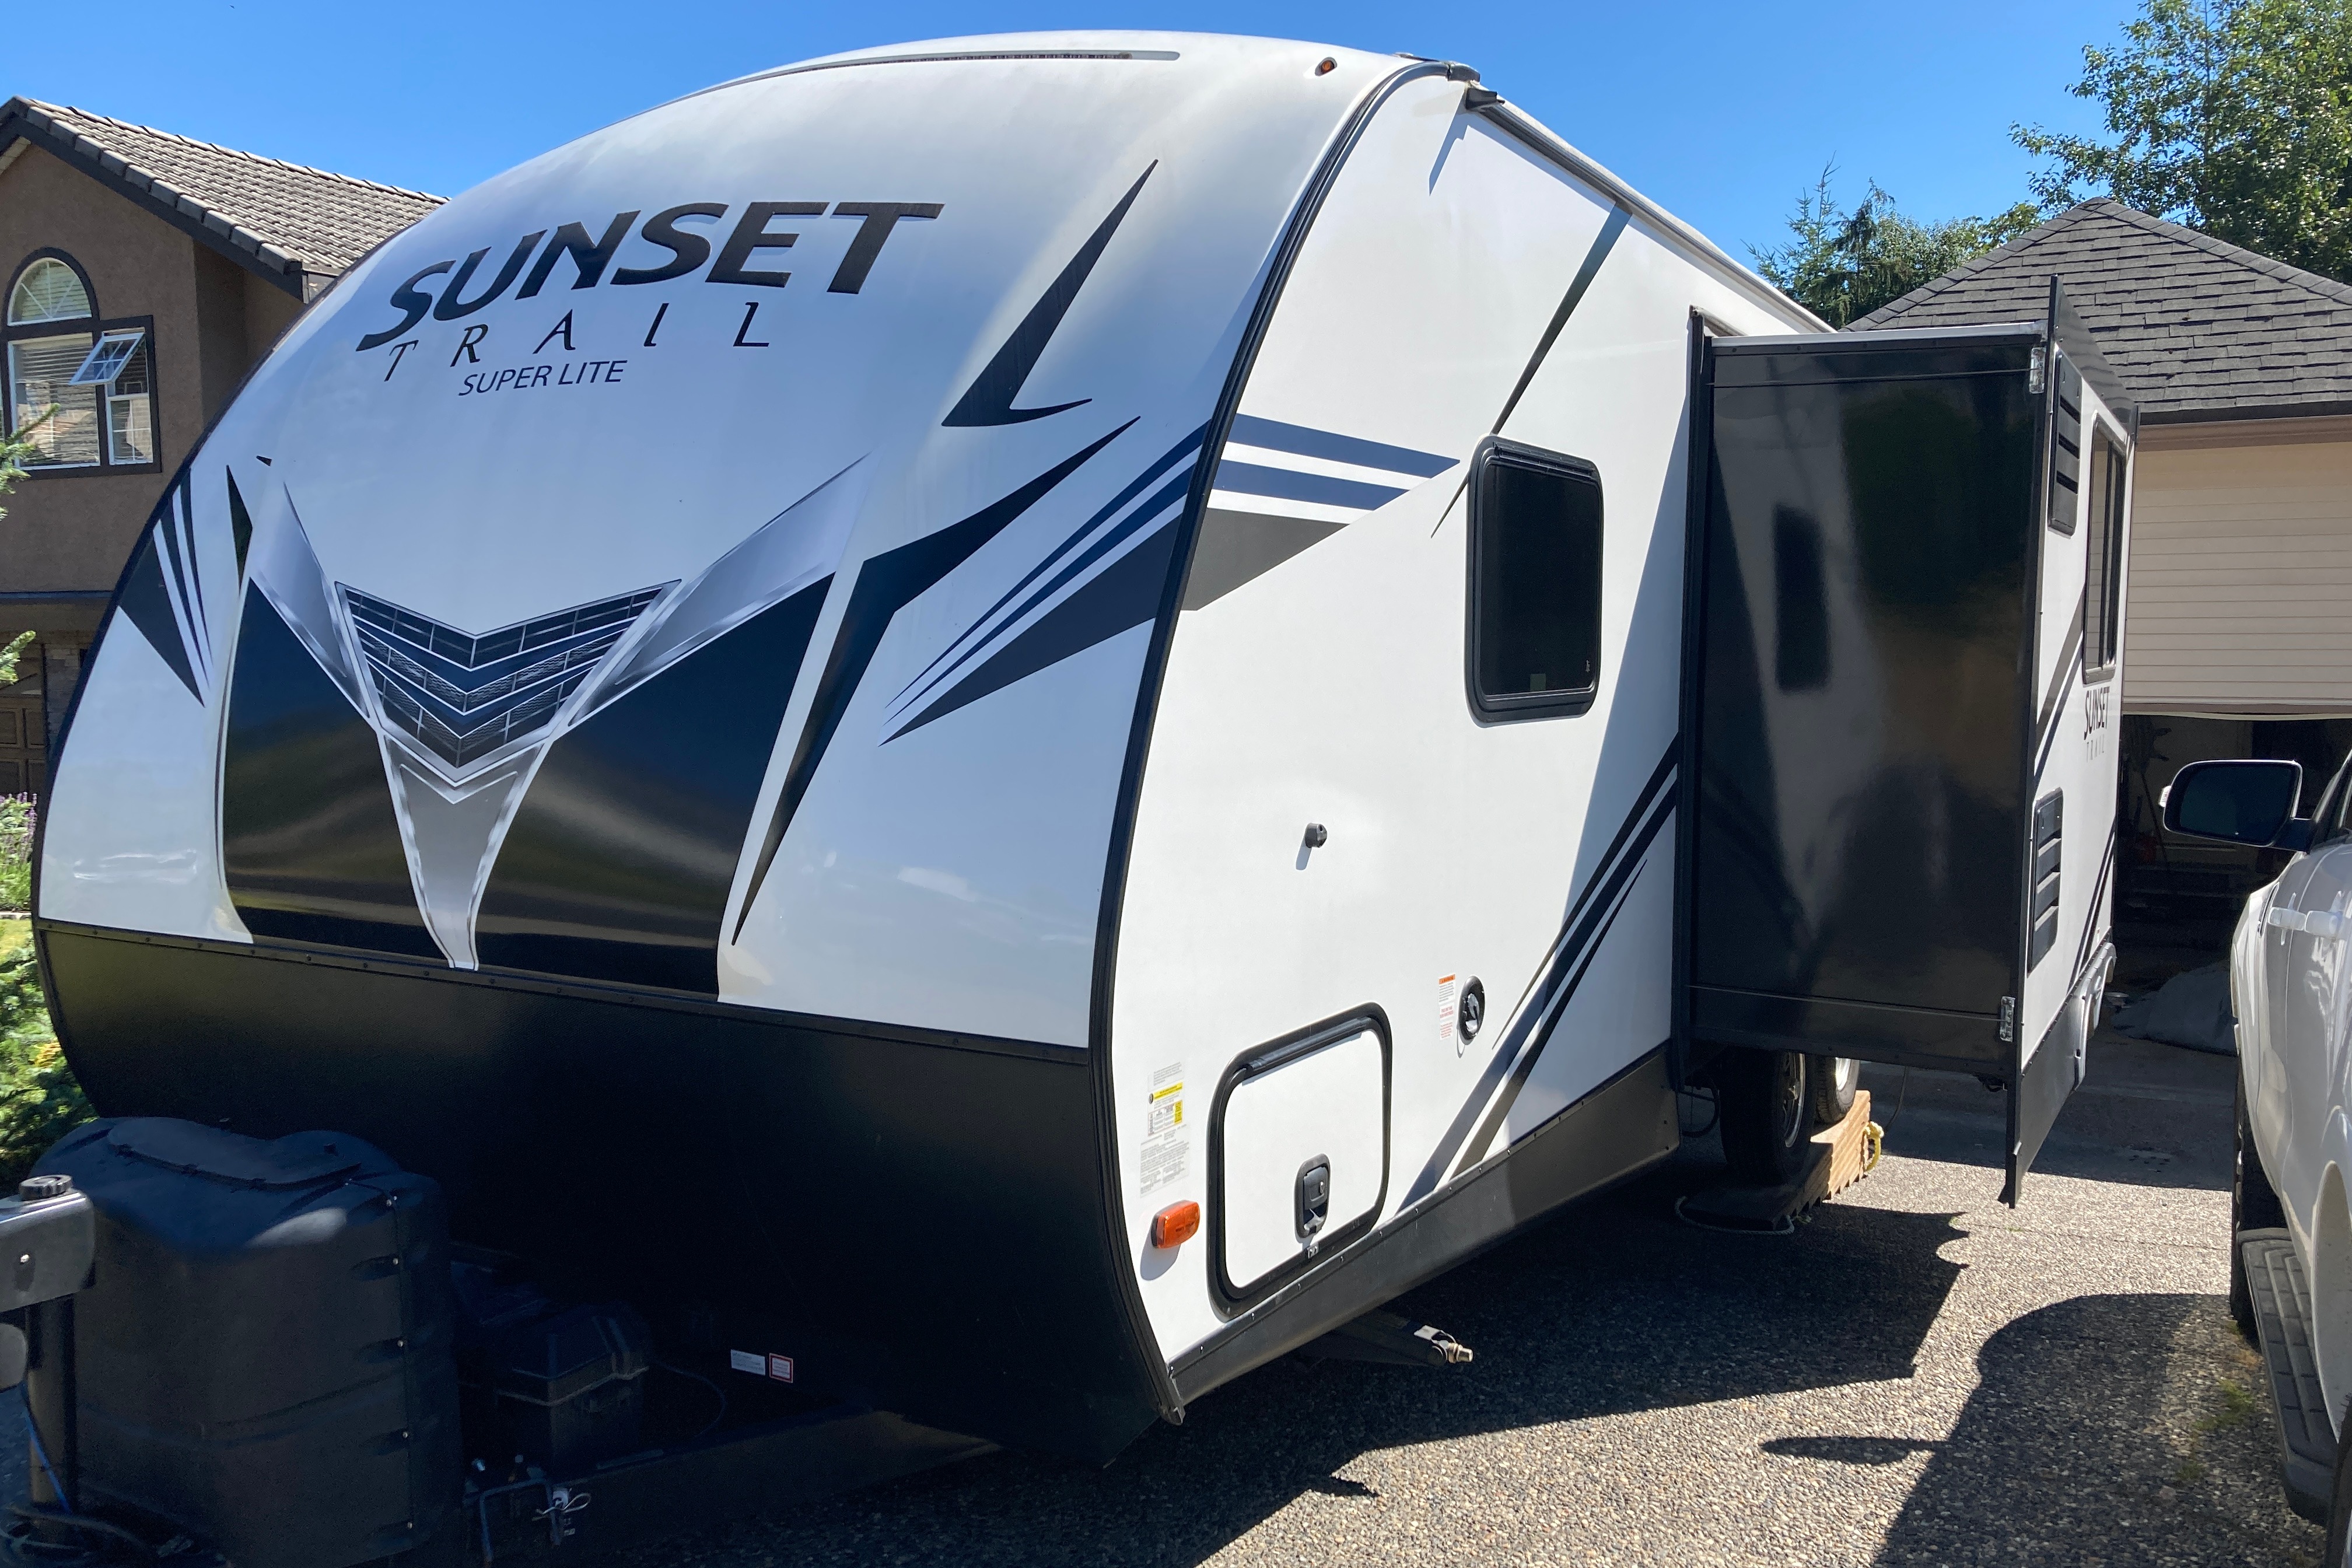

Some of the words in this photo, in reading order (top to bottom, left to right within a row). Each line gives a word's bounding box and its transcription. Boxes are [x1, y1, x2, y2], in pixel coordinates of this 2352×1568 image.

[355, 201, 946, 352] SUNSET
[384, 302, 770, 382] TRAIL
[457, 364, 554, 397] SUPER
[557, 359, 628, 386] LITE
[2084, 686, 2109, 740] SUNSET
[2086, 734, 2105, 763] TRAIL
